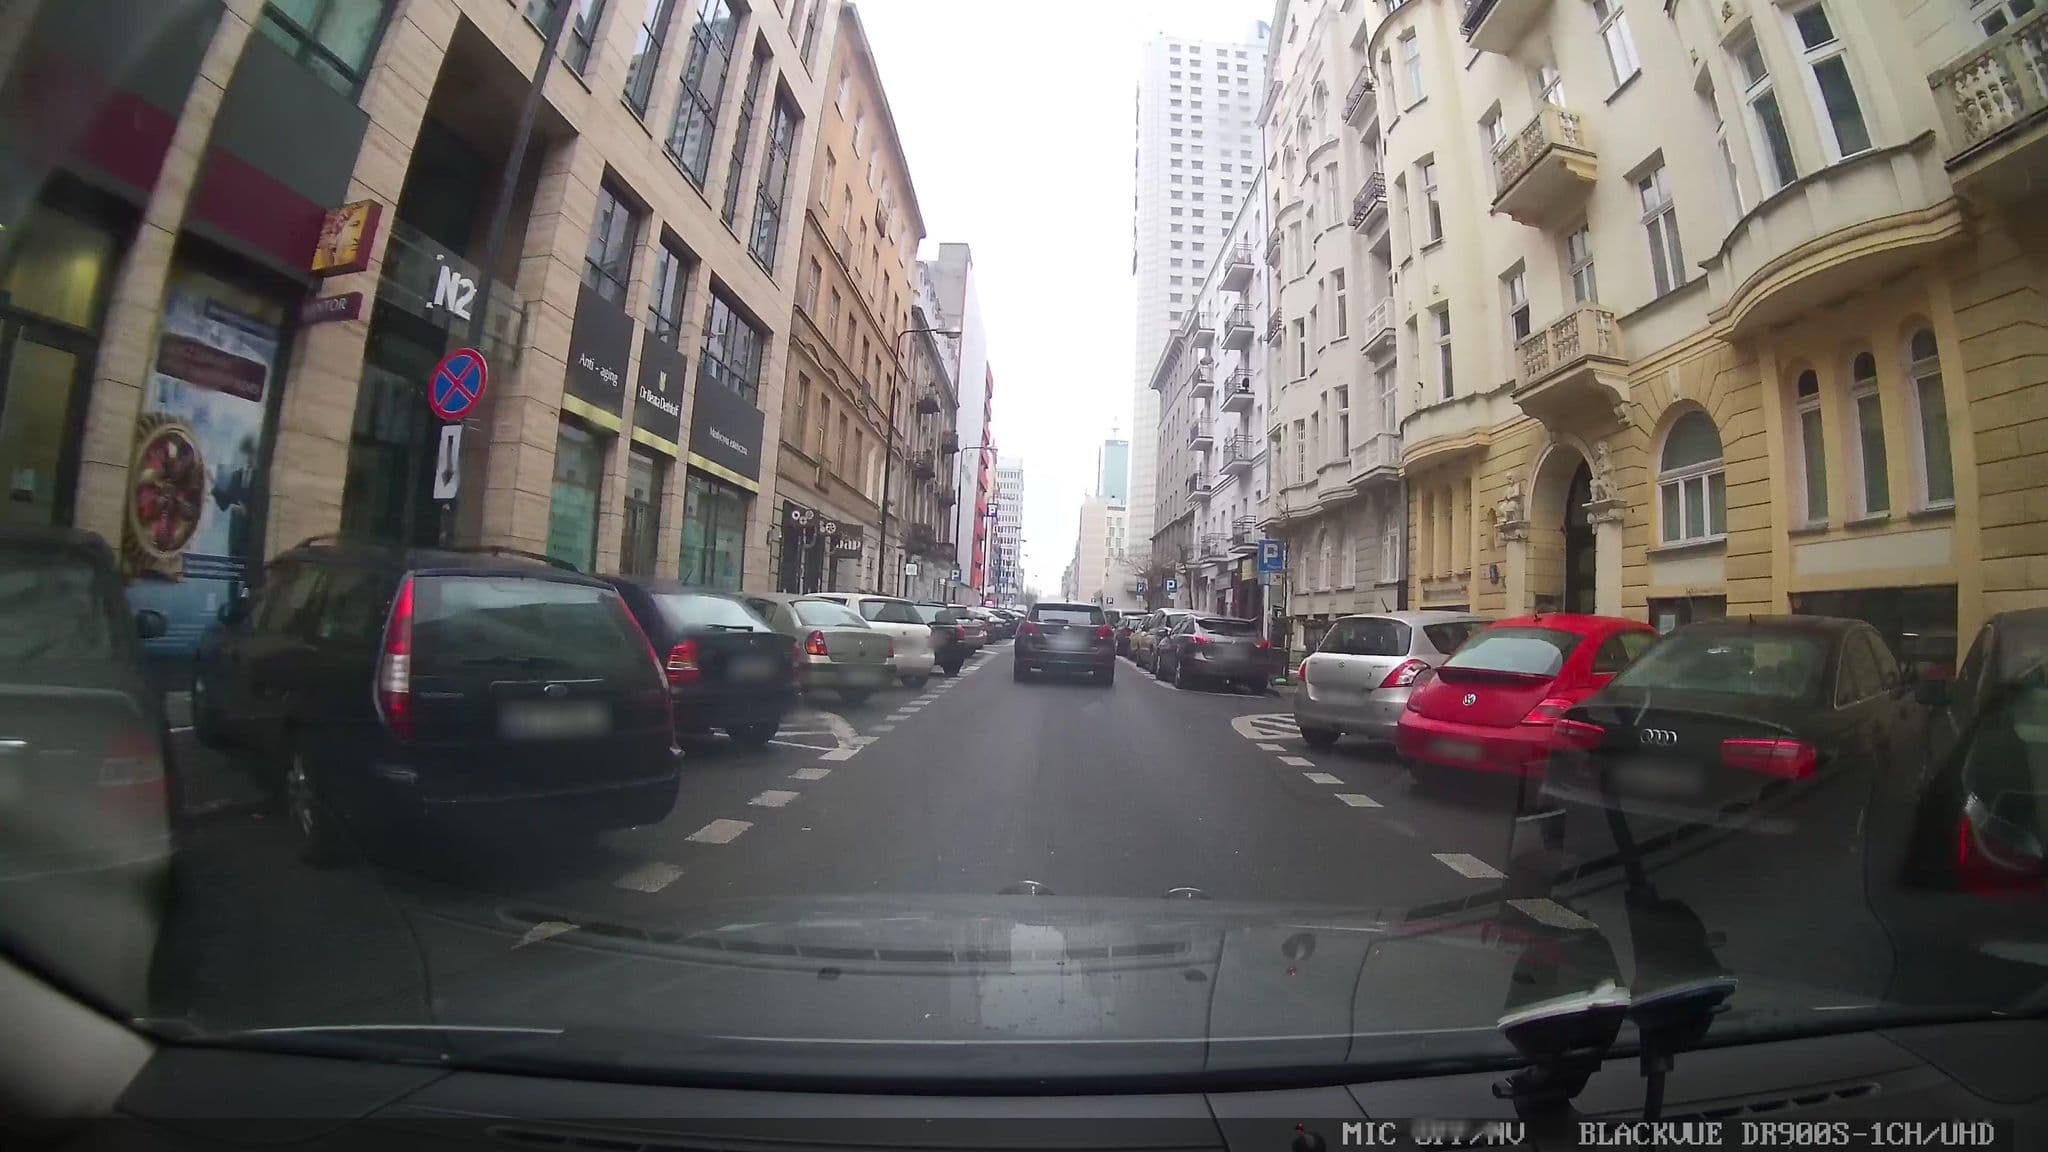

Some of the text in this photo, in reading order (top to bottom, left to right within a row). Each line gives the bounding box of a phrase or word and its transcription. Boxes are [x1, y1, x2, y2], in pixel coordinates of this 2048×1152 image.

[579, 353, 594, 371] Anti
[600, 367, 618, 387] aging
[640, 385, 647, 399] Dr
[1263, 543, 1278, 564] P
[952, 569, 960, 580] P
[1167, 580, 1175, 591] P
